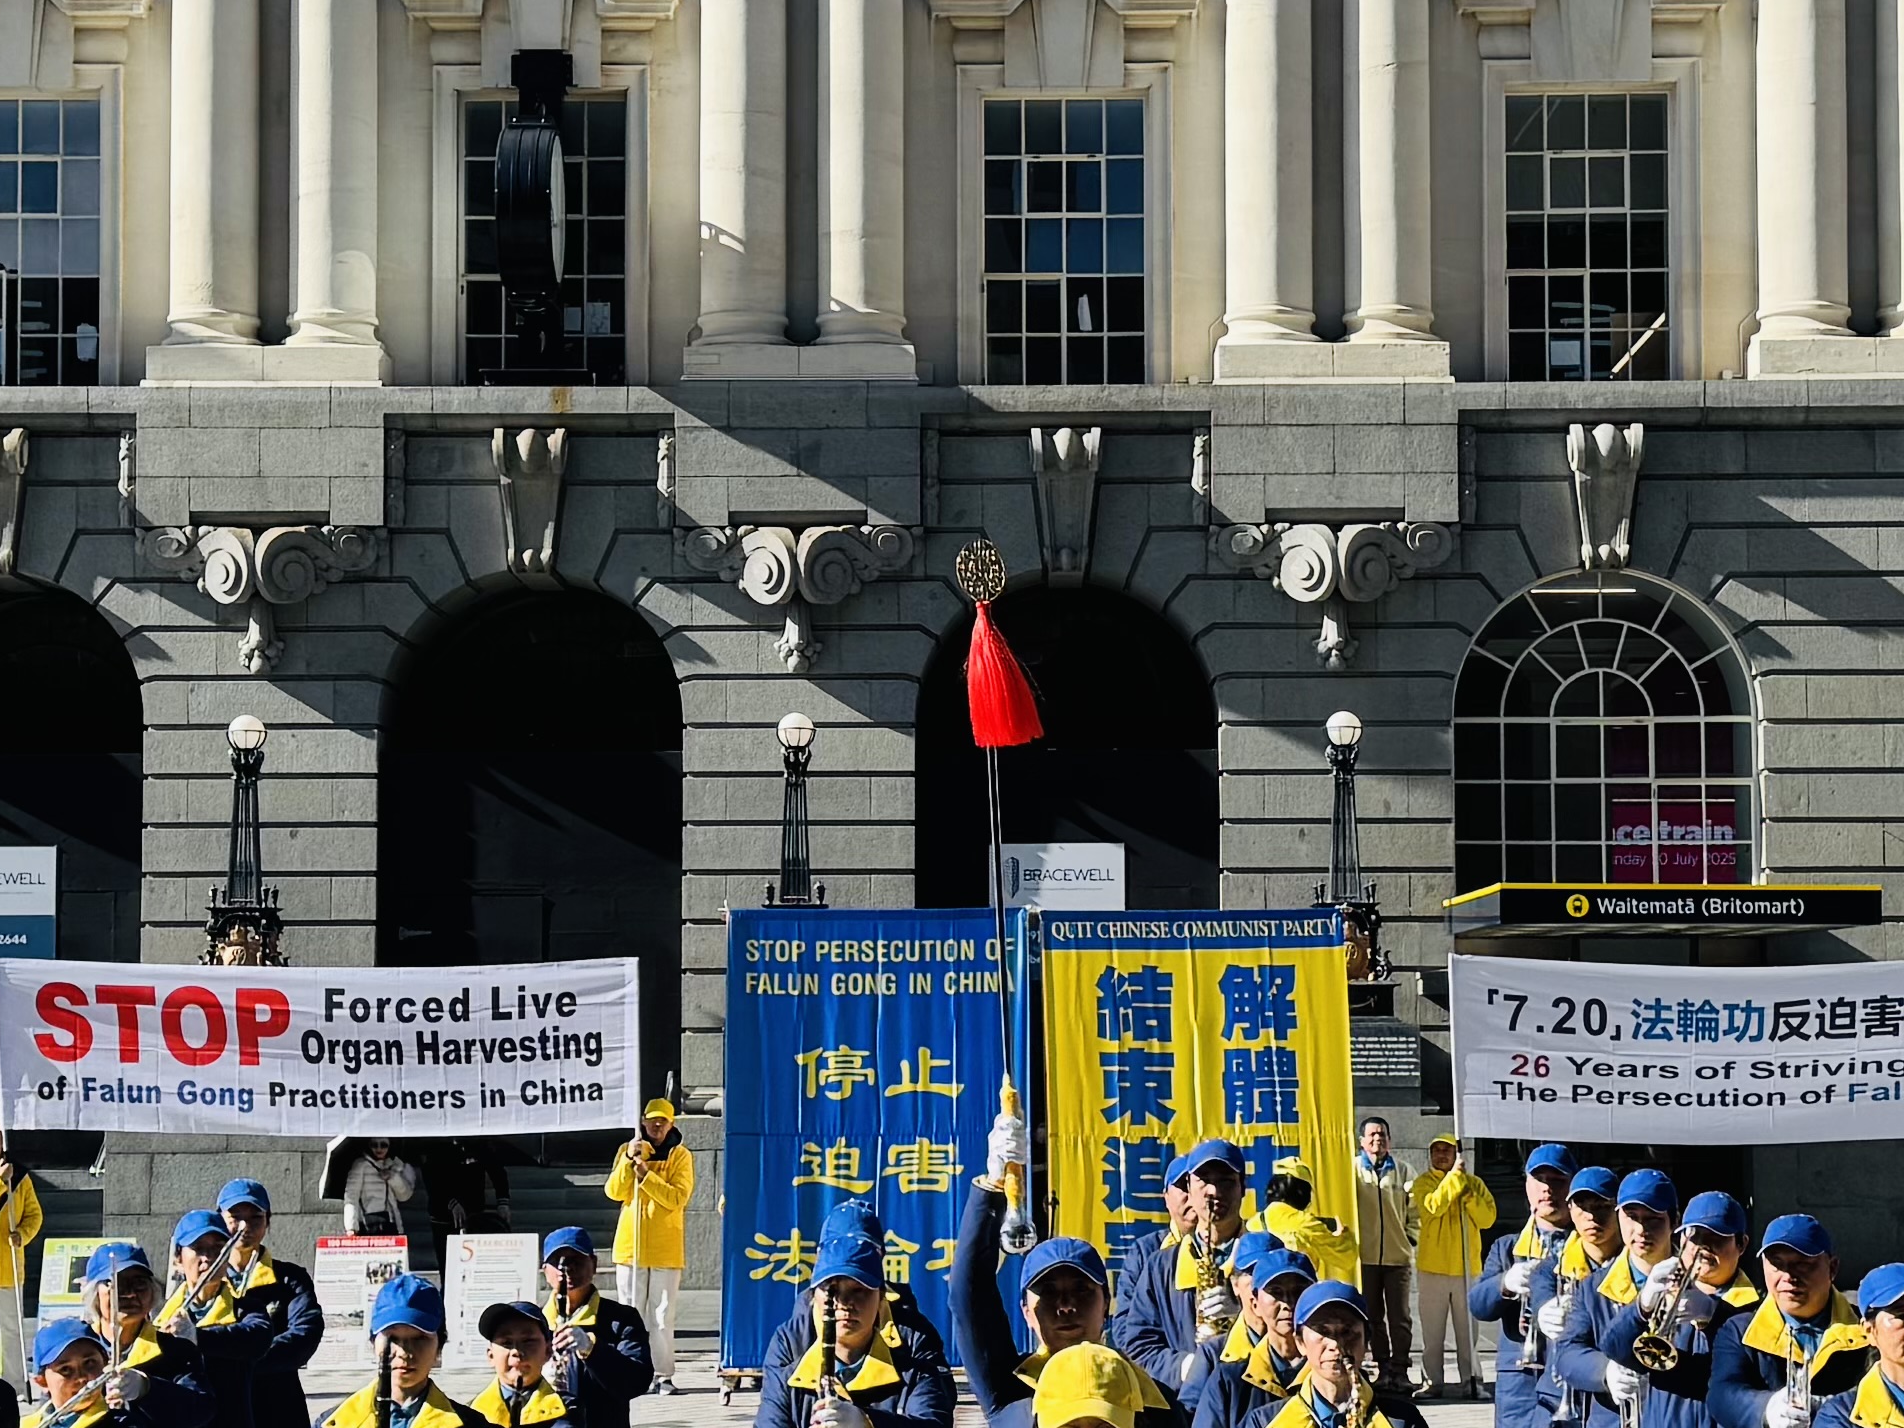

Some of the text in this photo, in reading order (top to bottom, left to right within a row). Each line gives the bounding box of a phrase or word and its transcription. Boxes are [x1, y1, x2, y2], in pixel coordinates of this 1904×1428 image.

[1612, 819, 1734, 844] ce train
[1614, 852, 1647, 867] nday
[1673, 852, 1698, 867] July
[1023, 868, 1115, 881] BRACEWELL
[1597, 897, 1805, 916] Waitematā (Britomart)
[1051, 919, 1336, 941] QUIT CHINESE COMMUNIST PARTY
[746, 939, 806, 962] STOP
[815, 939, 975, 962] PERSECUTION
[746, 972, 819, 995] FALUN
[831, 972, 897, 996] GONG
[909, 972, 932, 994] IN
[324, 985, 578, 1023] Forced Live
[34, 981, 291, 1066] STOP
[300, 1025, 603, 1074] Organ Harvesting
[794, 1044, 965, 1101] 停止
[1510, 1054, 1550, 1078] 26
[1565, 1056, 1680, 1079] Years
[1695, 1061, 1737, 1080] of
[37, 1076, 604, 1113] of Falun Gong Practitioners in China
[1492, 1080, 1557, 1103] The
[1571, 1084, 1786, 1107] Persecution
[1800, 1084, 1836, 1104] of
[792, 1136, 964, 1194] 迫害
[460, 1240, 474, 1262] 5
